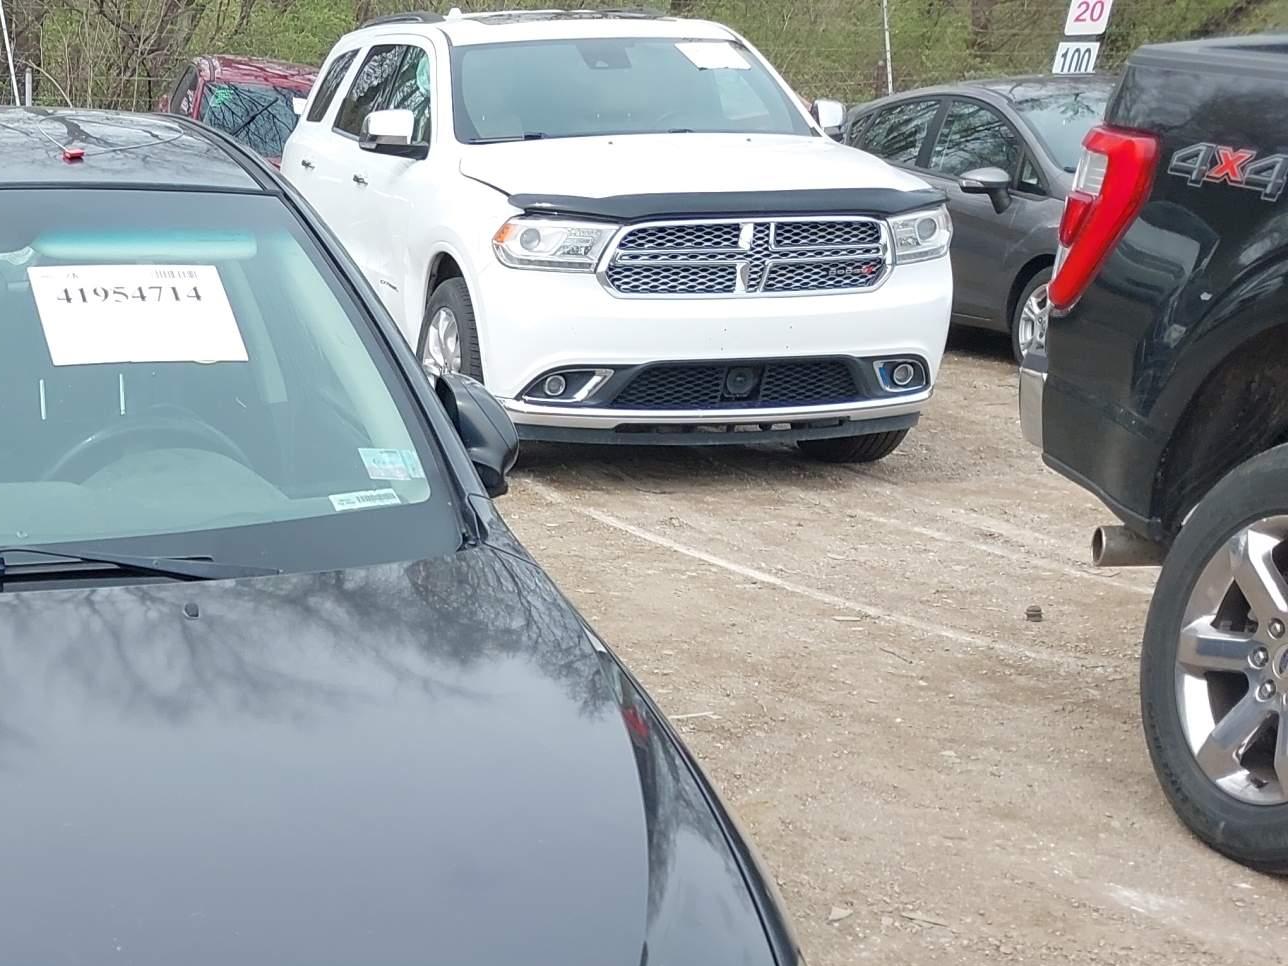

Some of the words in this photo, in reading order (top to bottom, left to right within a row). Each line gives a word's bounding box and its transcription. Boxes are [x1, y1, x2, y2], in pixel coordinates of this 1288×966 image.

[1073, 0, 1105, 23] 20
[1060, 47, 1092, 73] 100
[56, 285, 203, 304] 41954714
